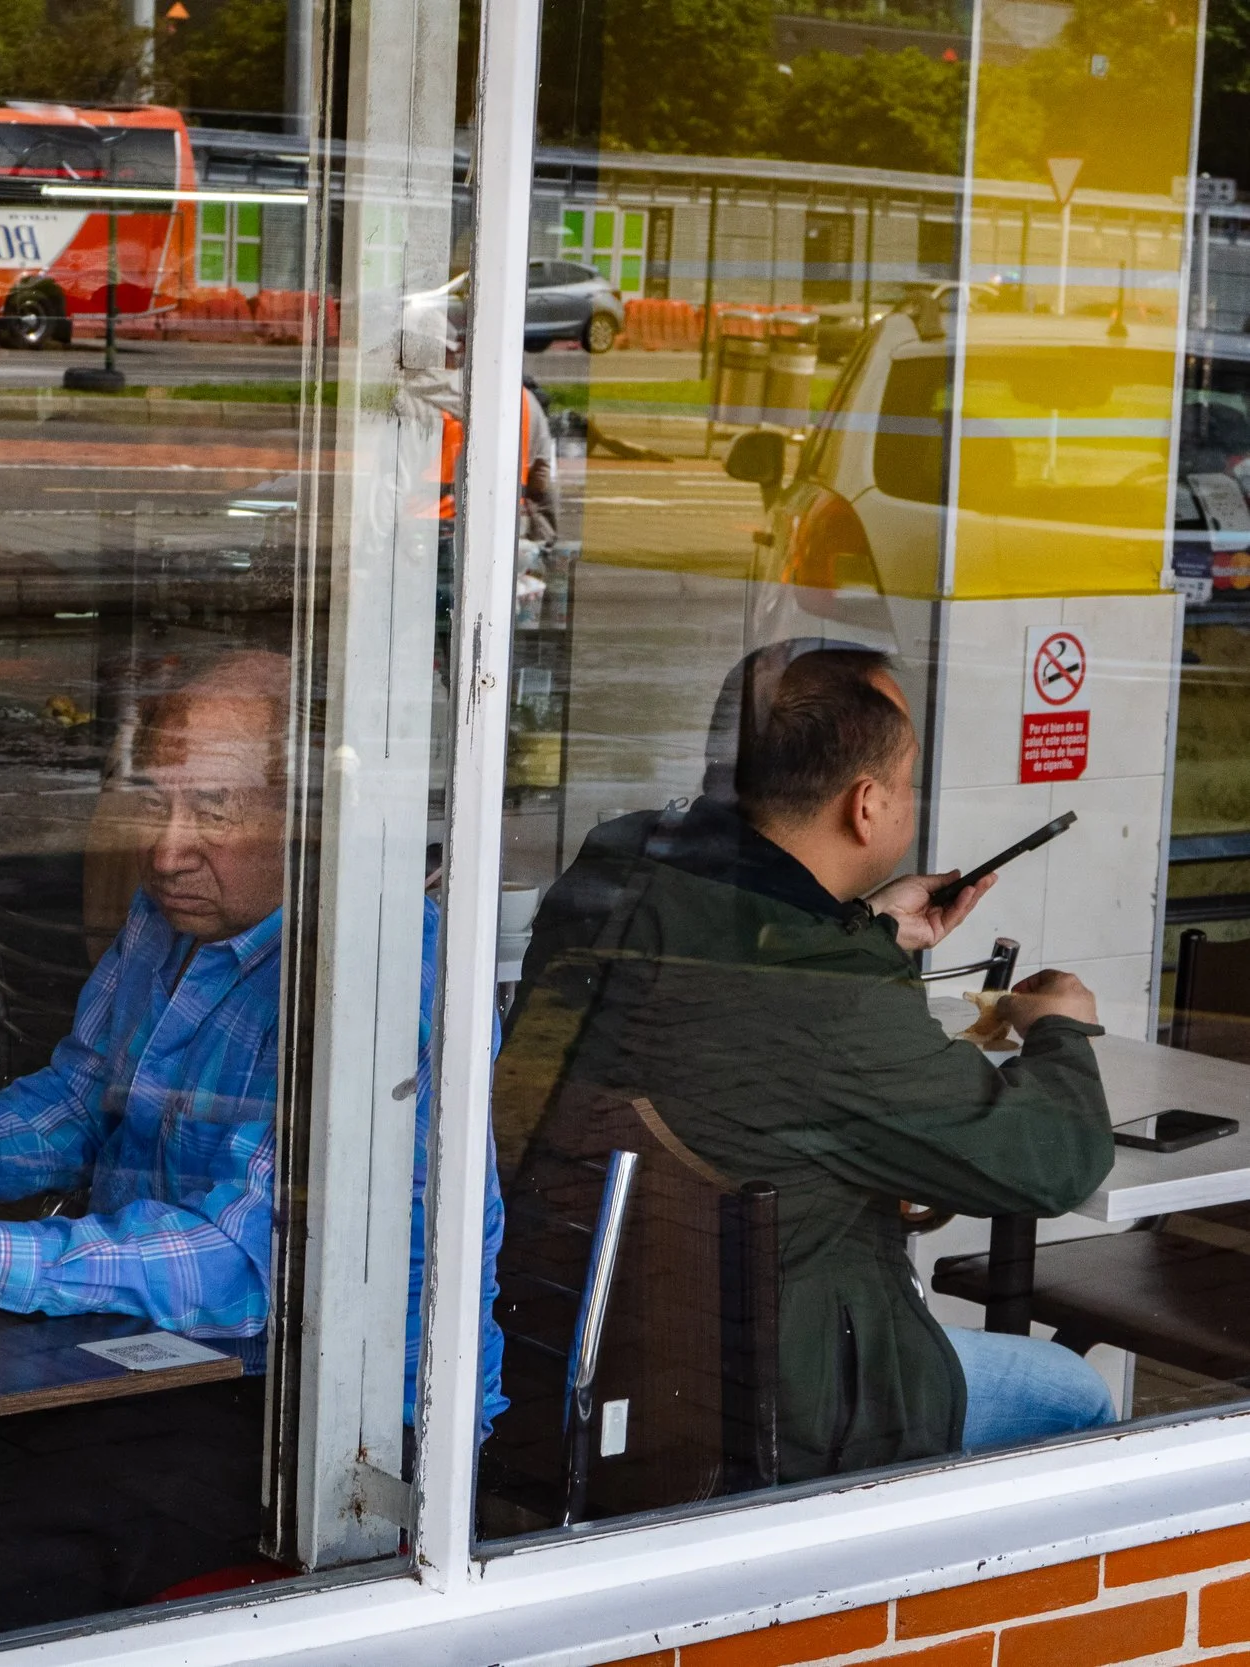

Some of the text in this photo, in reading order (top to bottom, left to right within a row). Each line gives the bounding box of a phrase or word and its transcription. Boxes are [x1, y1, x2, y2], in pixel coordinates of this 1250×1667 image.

[1029, 721, 1085, 735] Por el bien de su
[1045, 735, 1060, 747] este
[1060, 733, 1087, 746] espacio
[1024, 745, 1086, 760] está libre de humo
[1033, 760, 1043, 772] de
